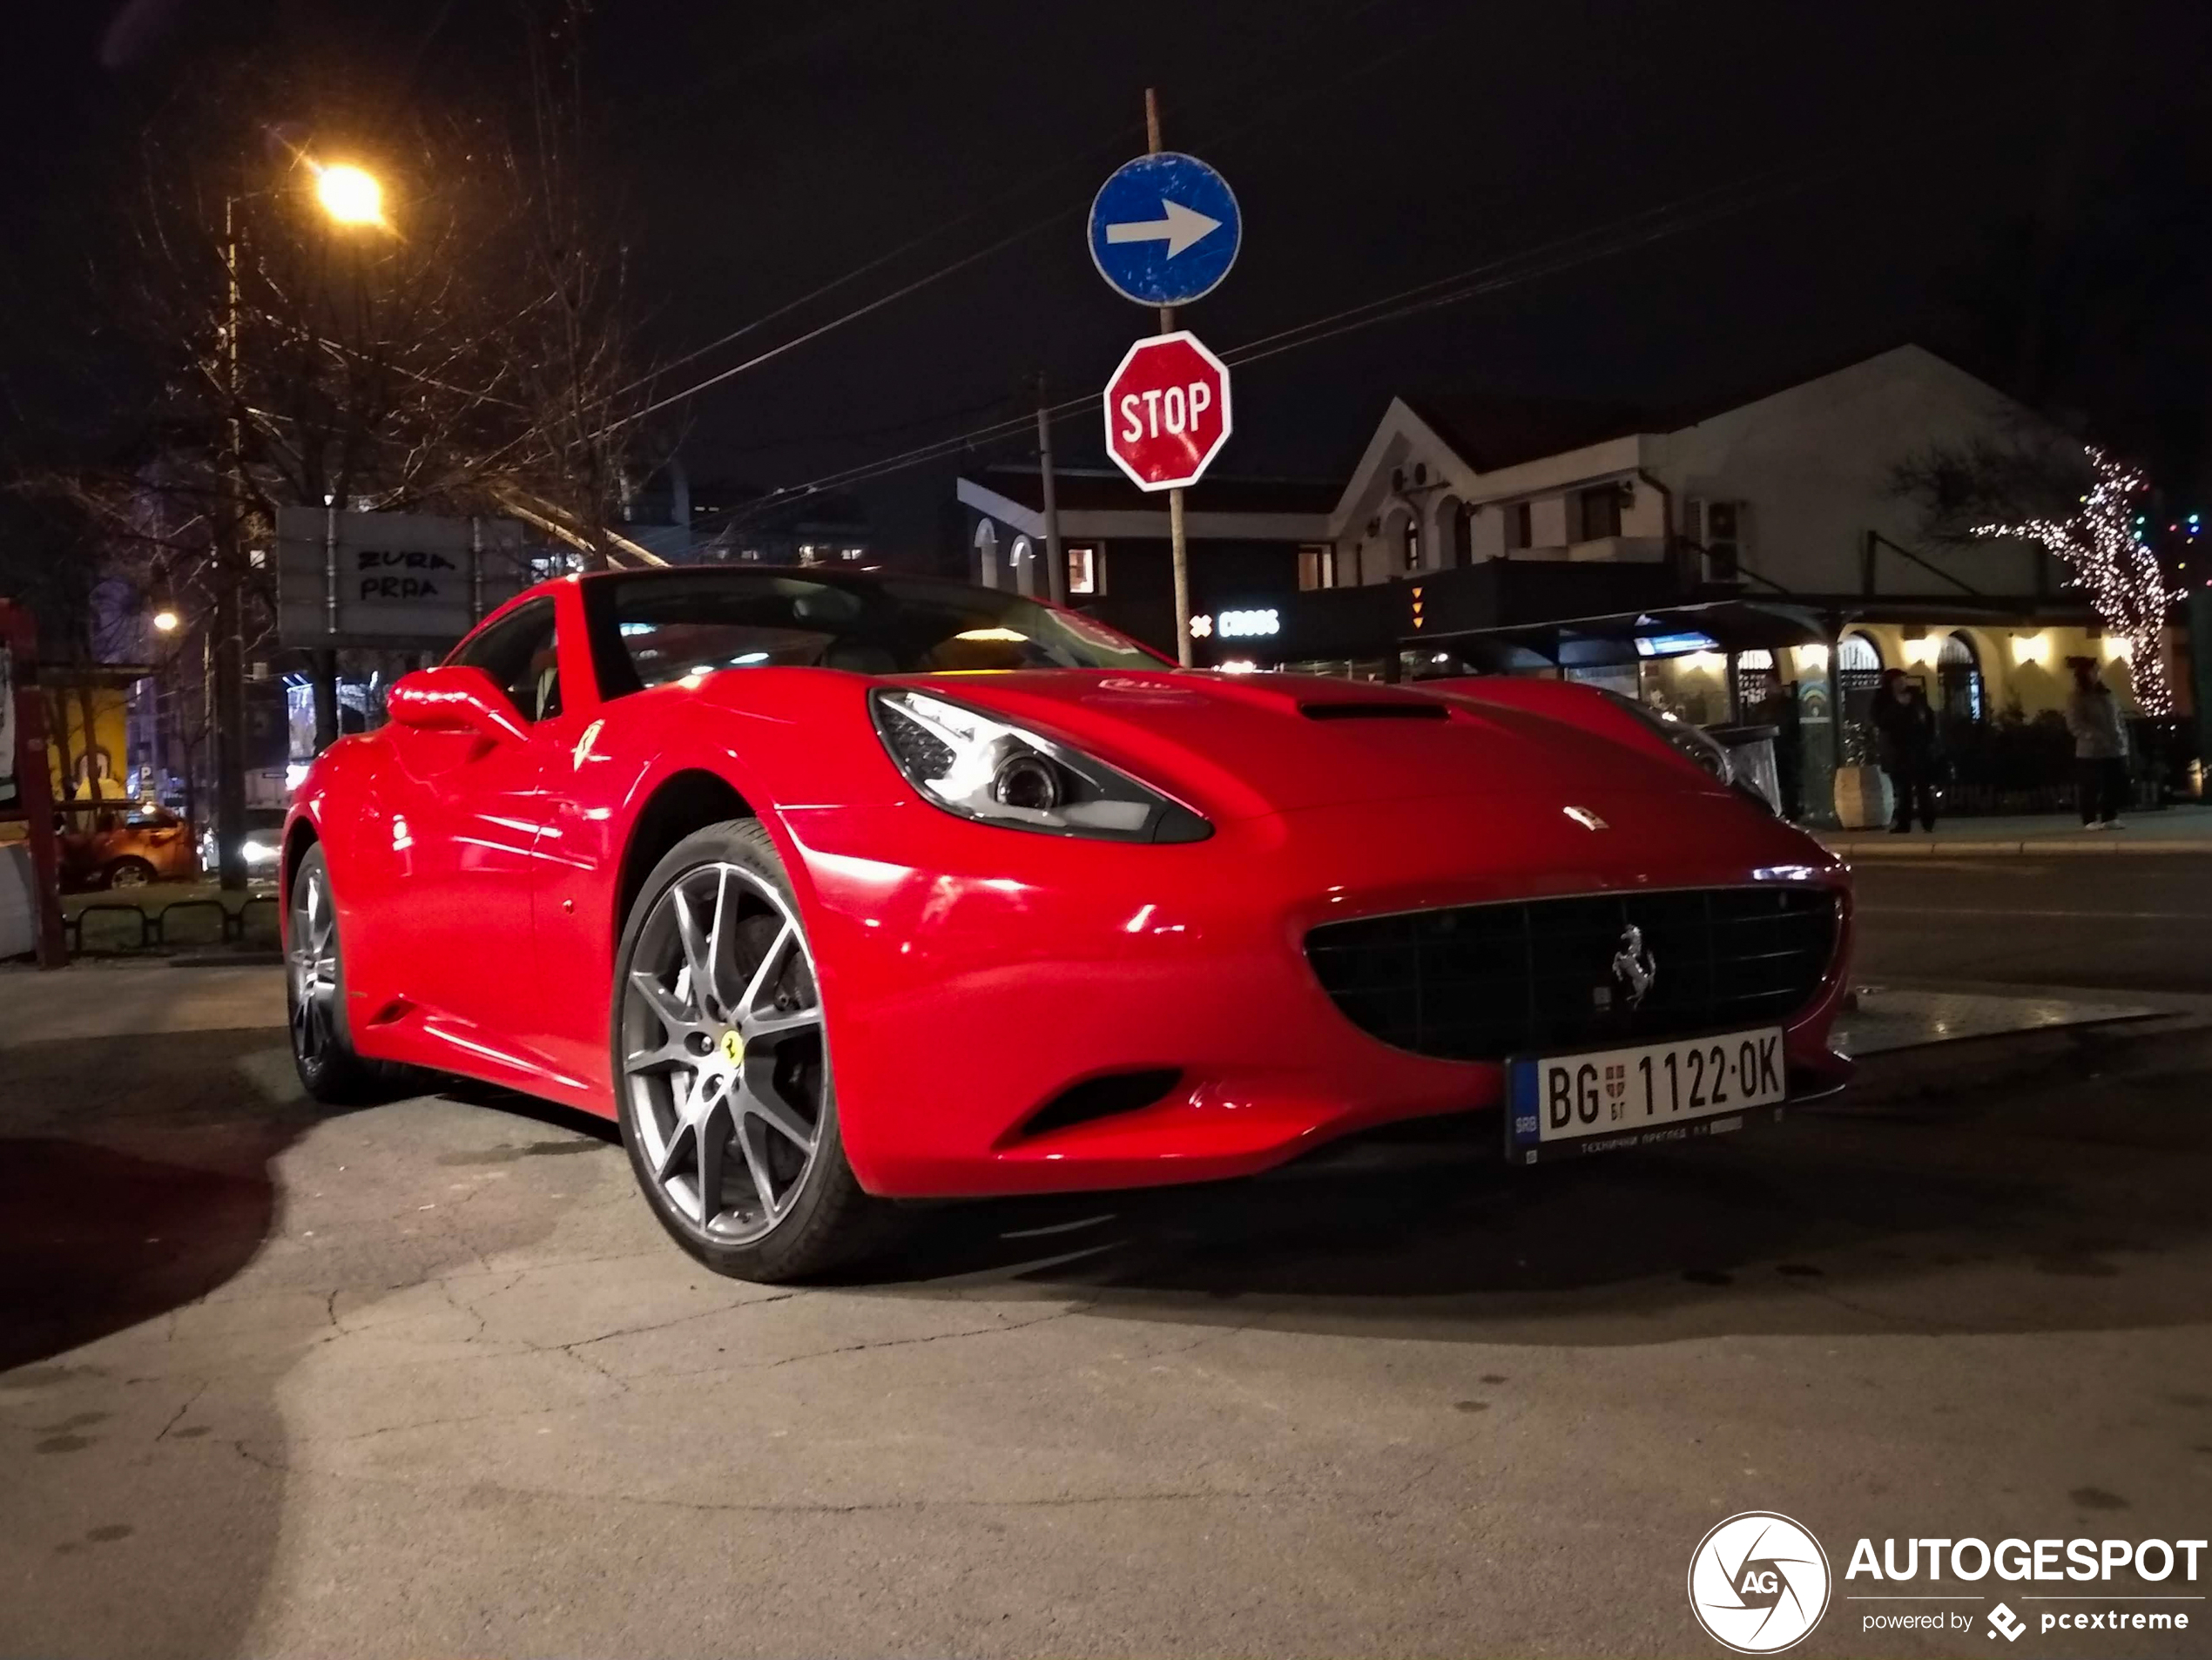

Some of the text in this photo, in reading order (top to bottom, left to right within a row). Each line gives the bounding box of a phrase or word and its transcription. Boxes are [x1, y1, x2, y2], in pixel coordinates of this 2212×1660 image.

[1121, 381, 1211, 443] STOP
[358, 551, 455, 570] ZURA
[1548, 1063, 1599, 1130] BG
[1516, 1116, 1537, 1134] SRB
